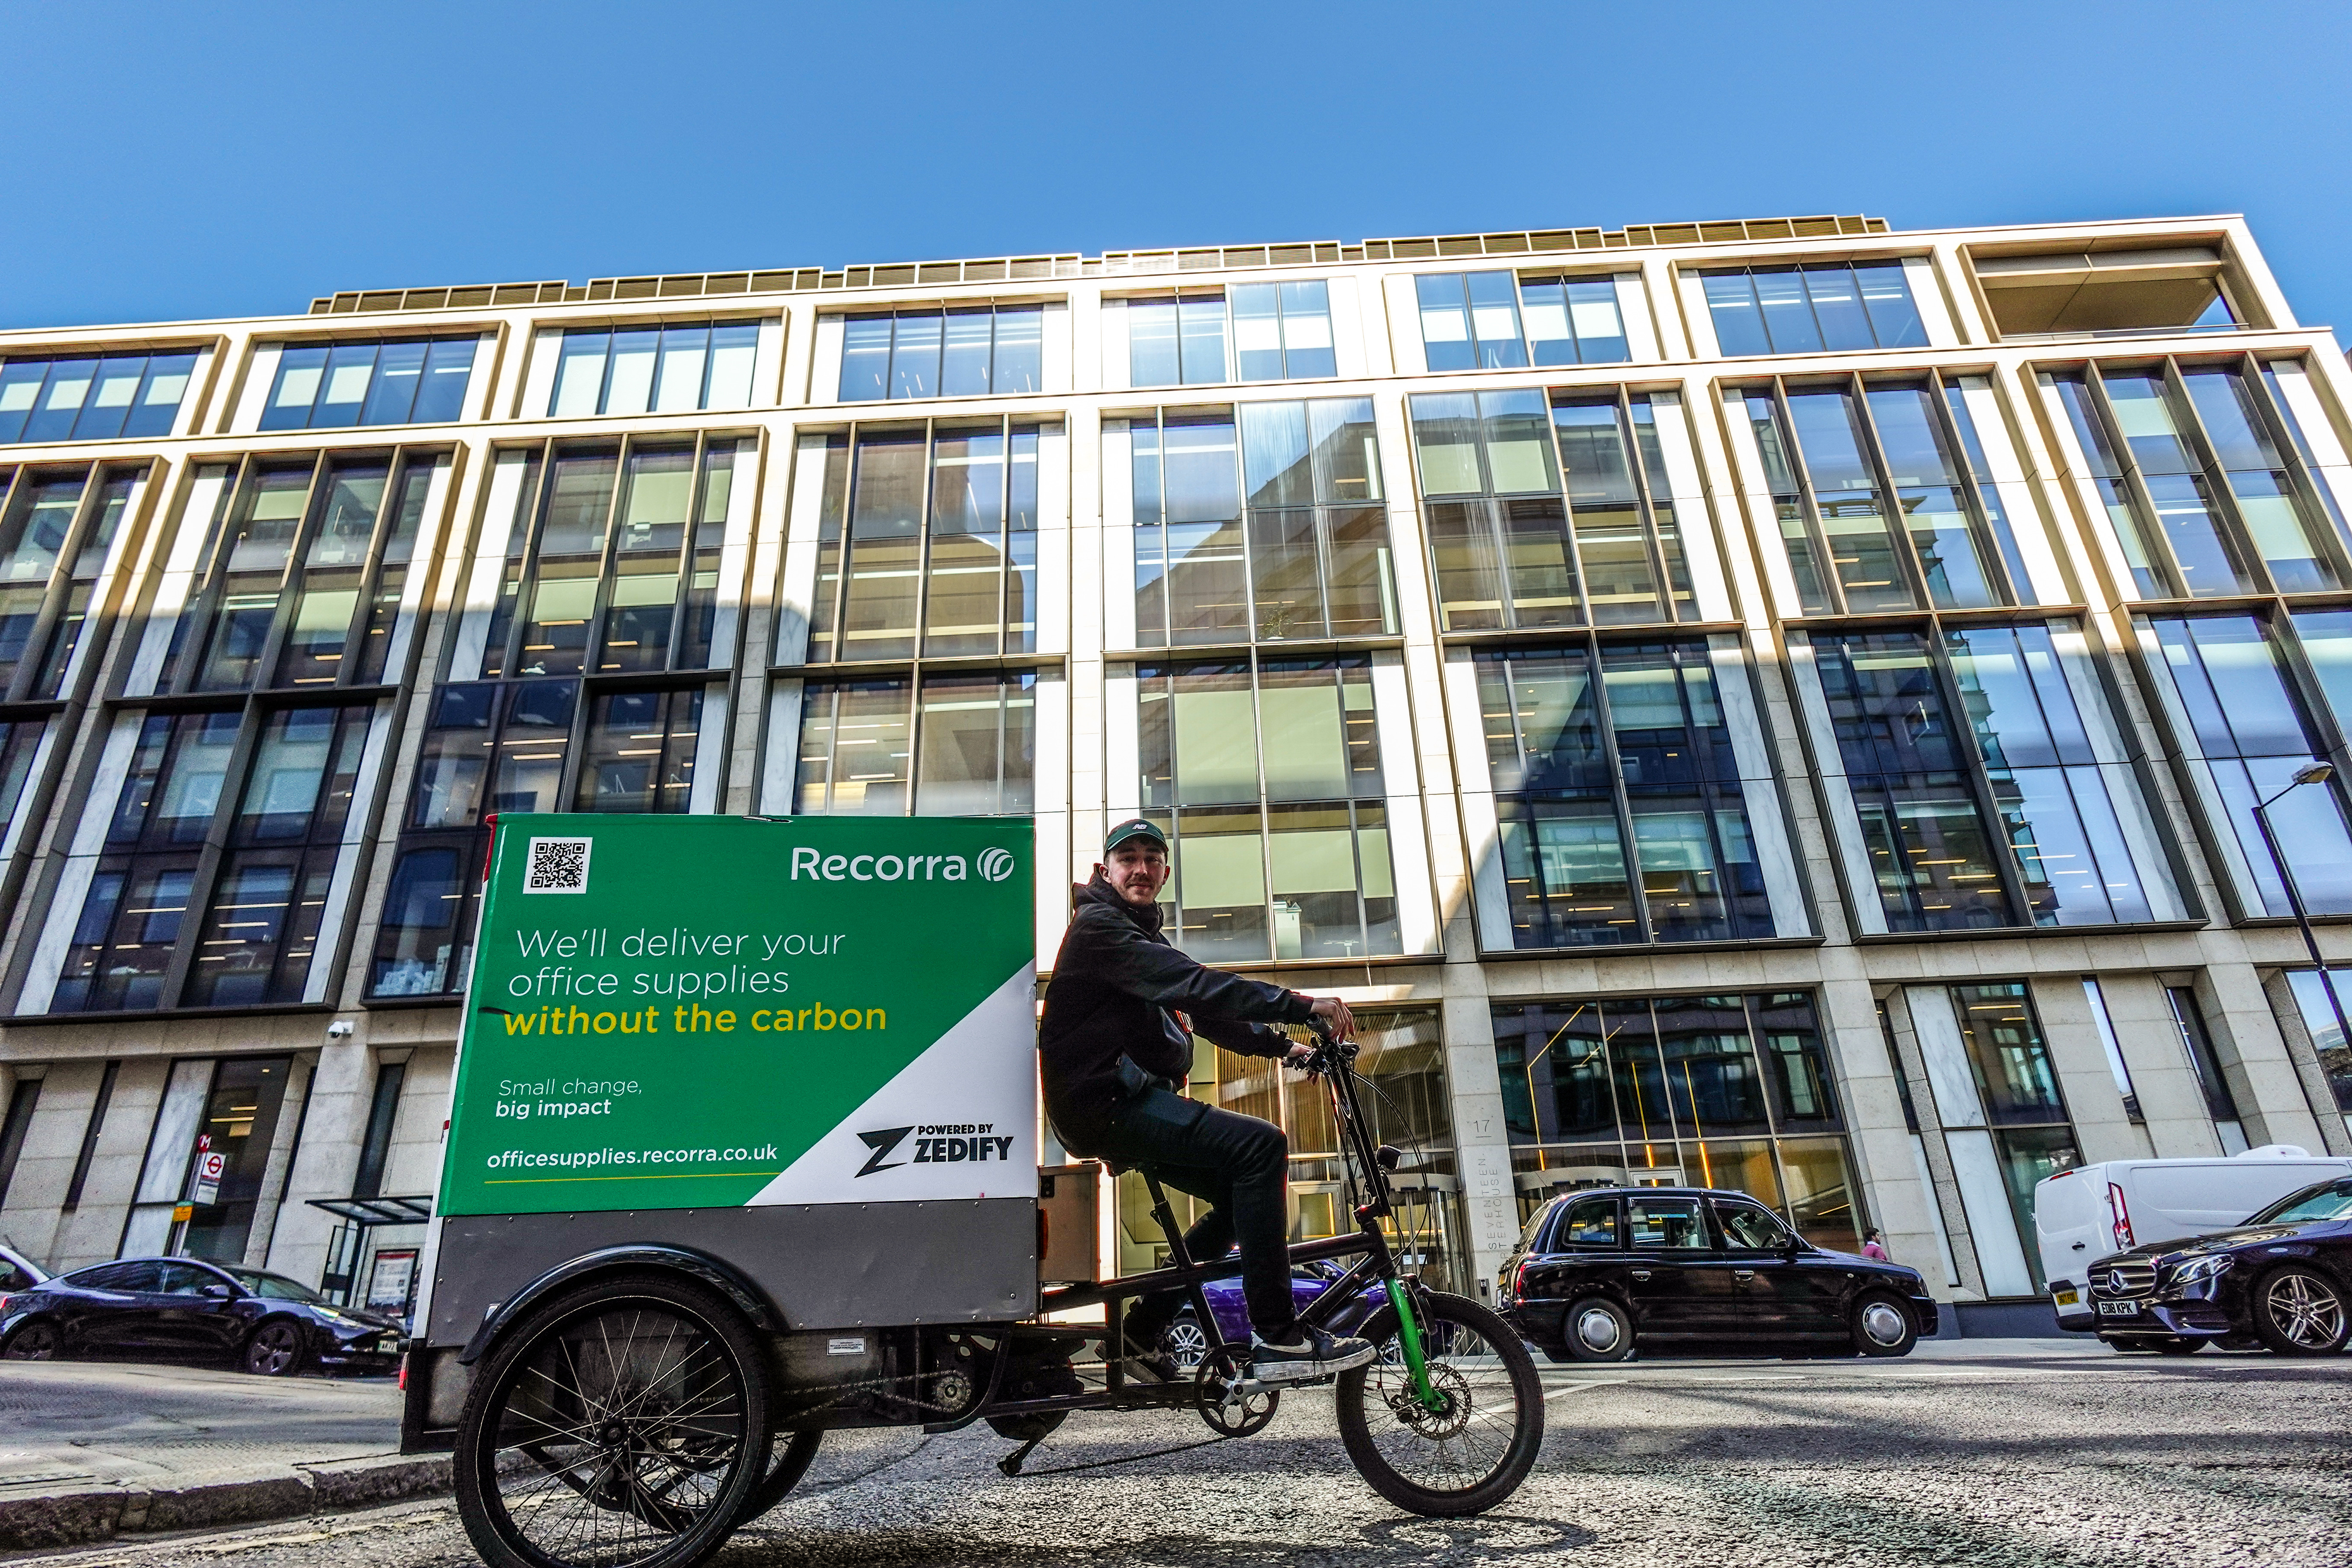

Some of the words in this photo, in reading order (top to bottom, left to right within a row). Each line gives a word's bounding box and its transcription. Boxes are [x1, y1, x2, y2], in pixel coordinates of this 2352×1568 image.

[791, 847, 966, 881] Recorra
[517, 928, 606, 957] We'll
[622, 928, 749, 957] deliver
[762, 934, 845, 961] your
[509, 966, 618, 996] office
[632, 965, 788, 1000] supplies
[504, 1005, 659, 1035] without
[674, 1003, 737, 1032] the
[751, 1002, 886, 1032] carbon
[499, 1078, 555, 1096] Small
[563, 1078, 641, 1096] change,
[496, 1100, 530, 1120] big
[537, 1099, 612, 1118] impact
[918, 1124, 976, 1135] POWERED
[978, 1124, 994, 1134] BY
[1473, 1120, 1490, 1133] 17
[200, 1134, 212, 1149] M
[913, 1136, 1014, 1163] ZEDIFY
[487, 1143, 778, 1169] officesupplies.recorra.co.uk
[1478, 1158, 1497, 1250] SEVENTEEN
[1489, 1169, 1509, 1259] RTERHOUSE
[2116, 1302, 2133, 1314] KPK
